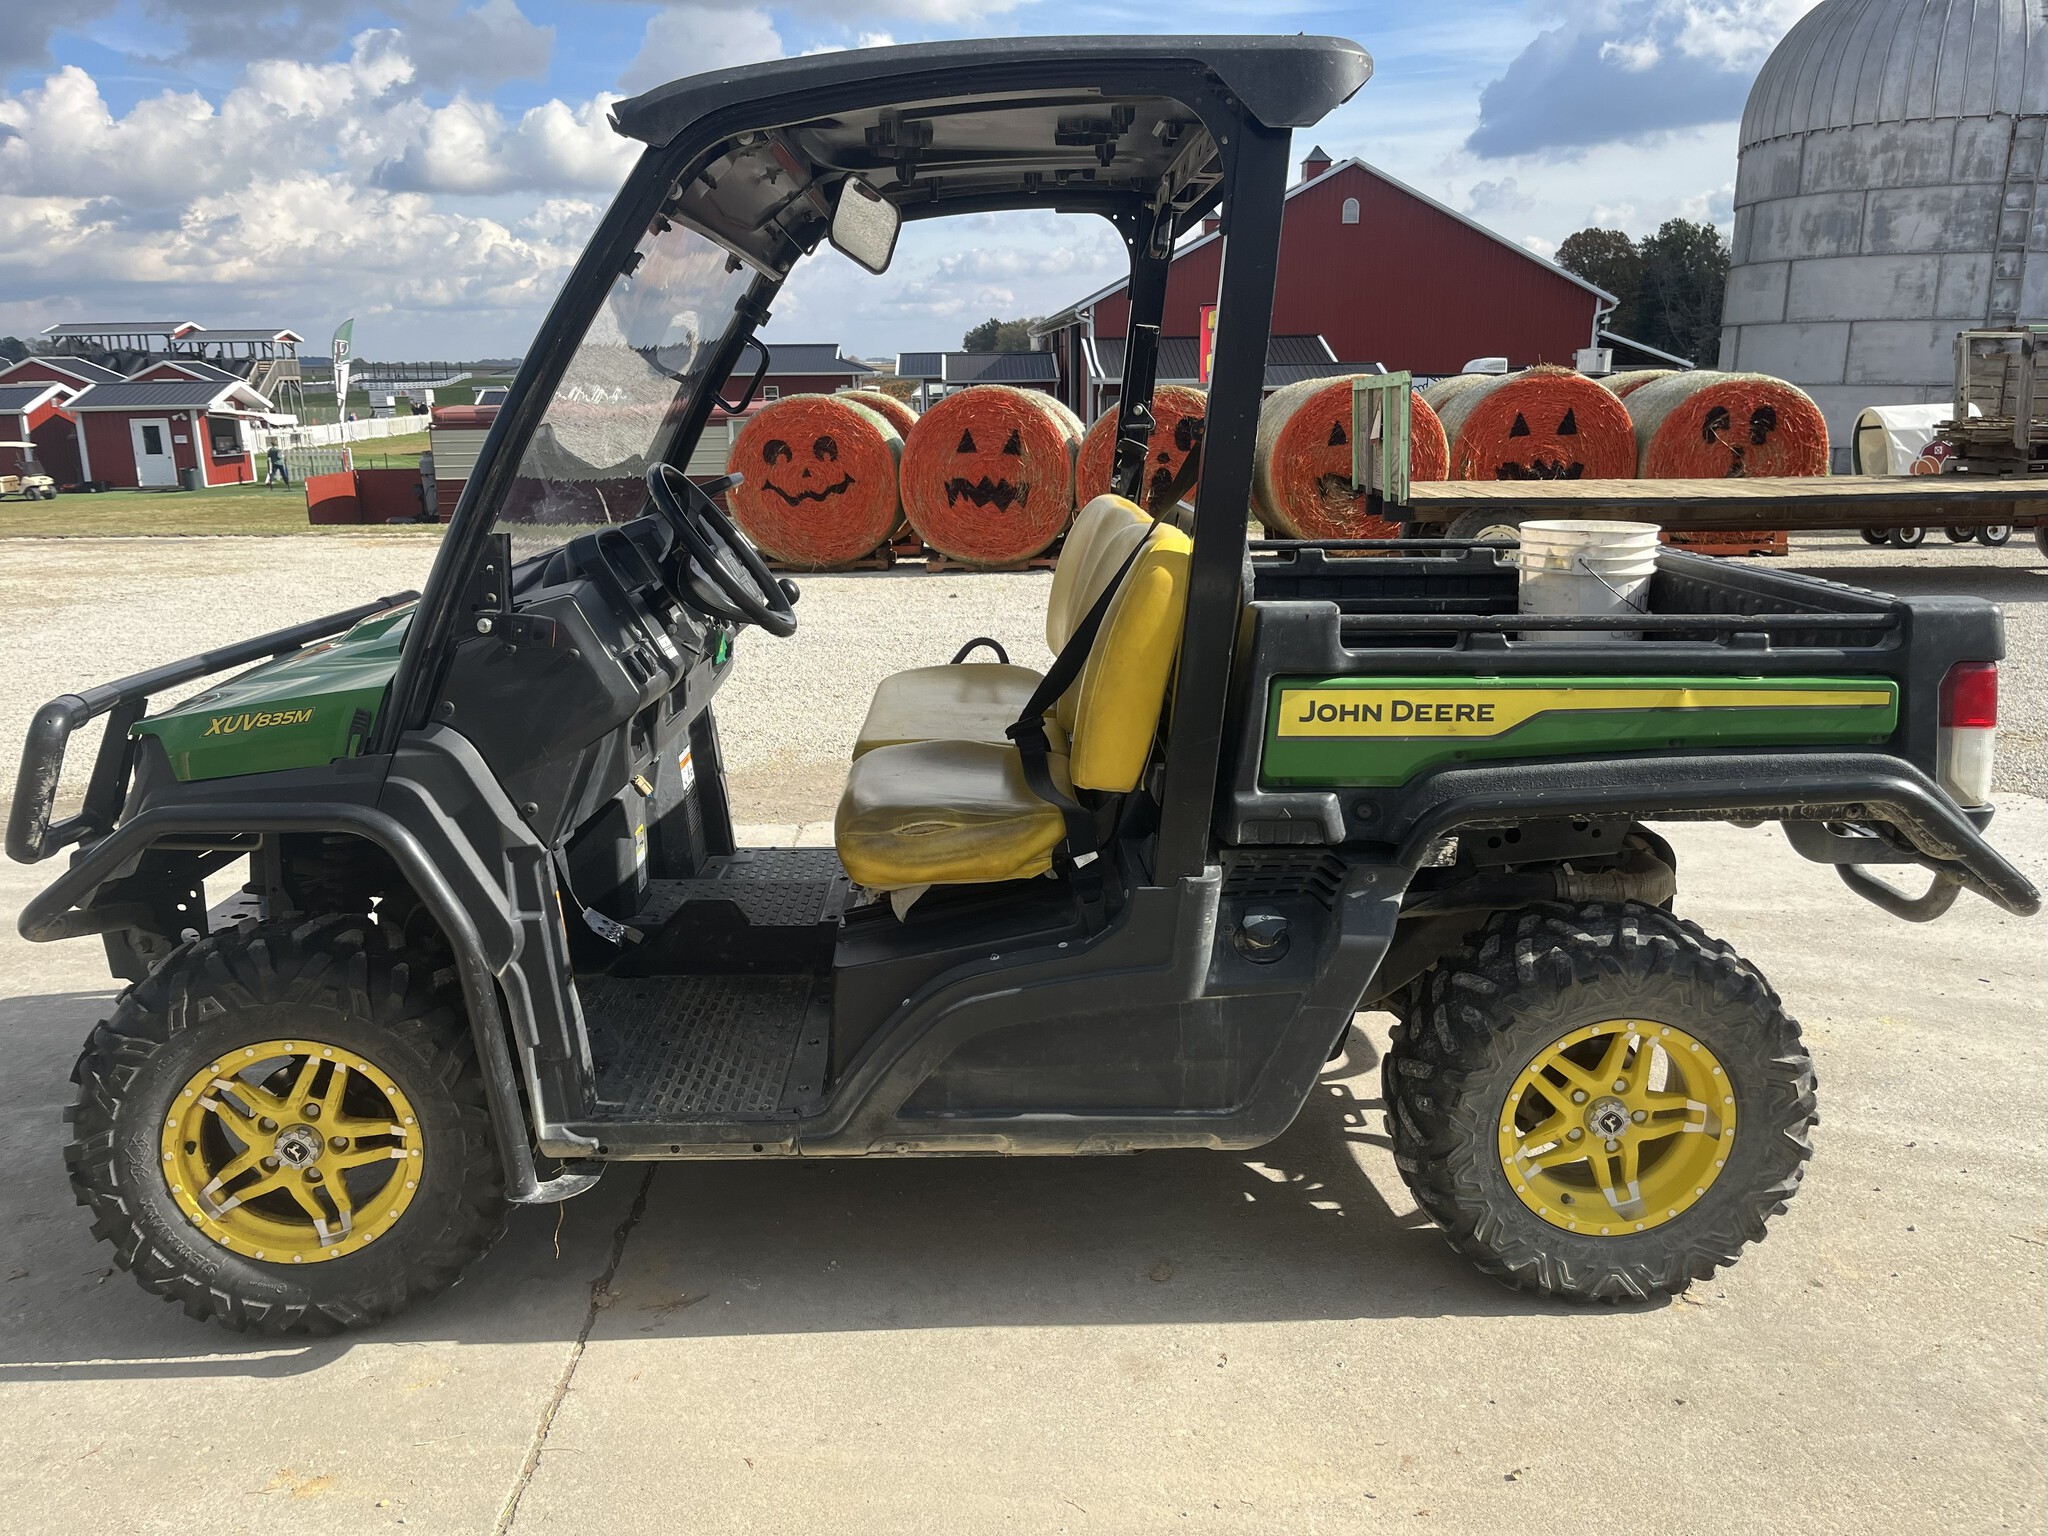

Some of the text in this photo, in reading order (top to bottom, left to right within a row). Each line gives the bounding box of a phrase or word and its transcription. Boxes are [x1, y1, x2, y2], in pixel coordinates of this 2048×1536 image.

[202, 708, 315, 737] XUV835M
[1298, 699, 1496, 723] JOHN DEERE
